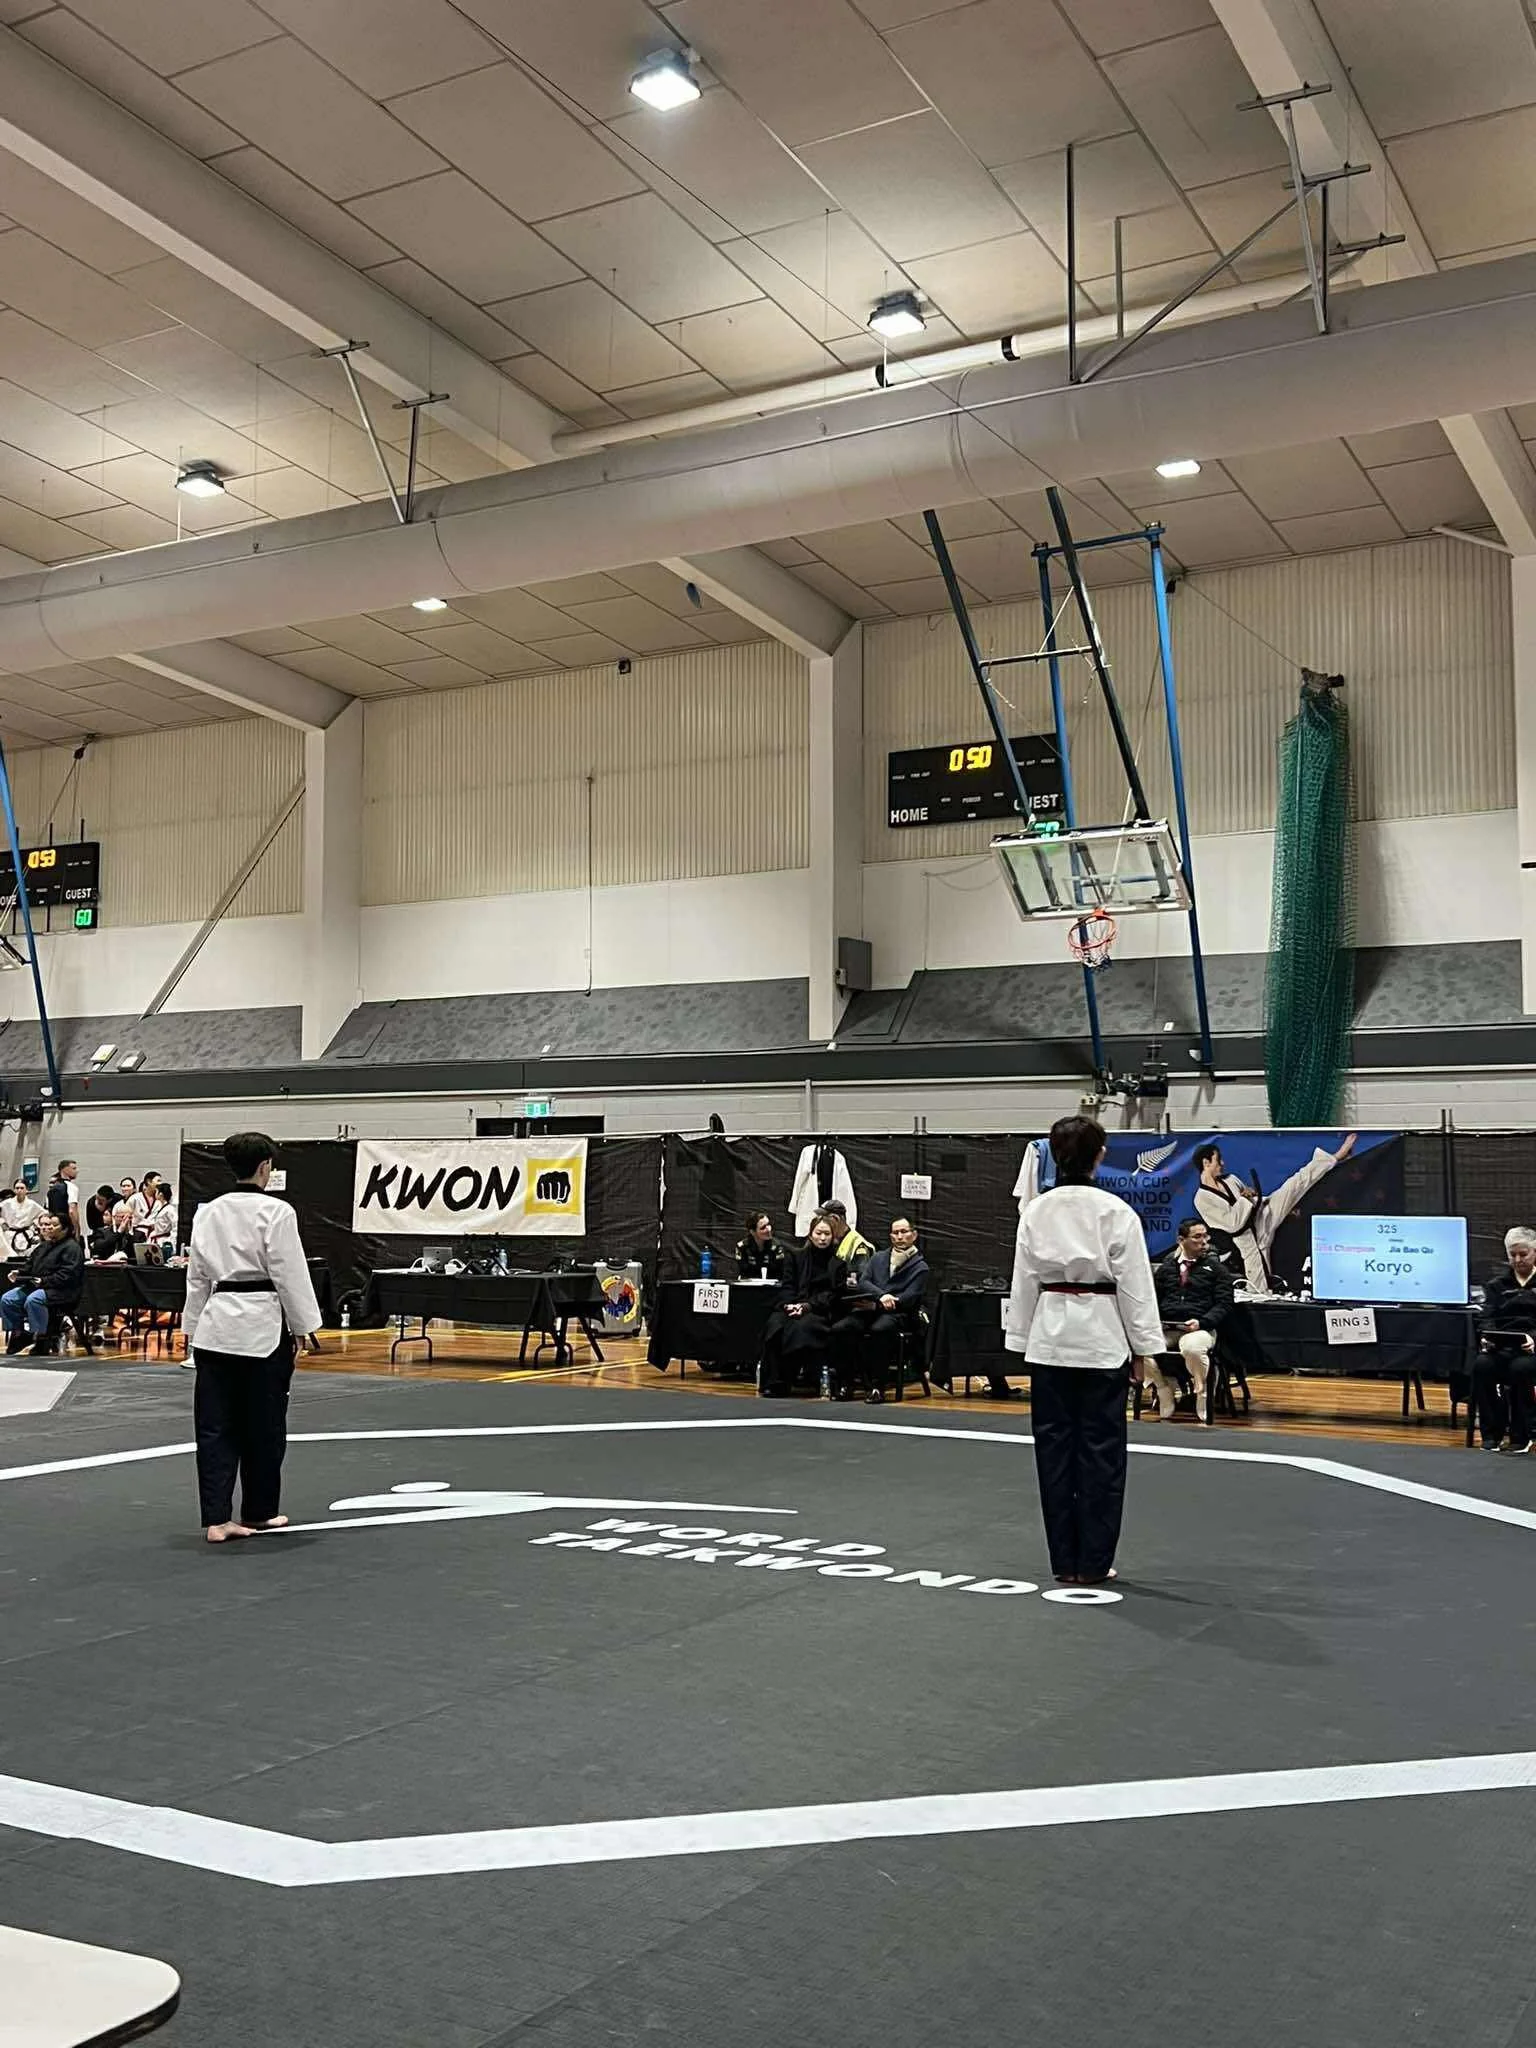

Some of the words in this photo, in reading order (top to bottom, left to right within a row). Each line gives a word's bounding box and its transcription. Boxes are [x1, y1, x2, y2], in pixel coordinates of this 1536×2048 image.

[890, 808, 928, 823] HOME
[65, 888, 92, 900] GUEST
[359, 1163, 521, 1212] KWON
[1142, 1177, 1170, 1188] CUP
[1121, 1191, 1172, 1204] ONDO
[1142, 1220, 1172, 1232] AND
[1364, 1259, 1413, 1276] Koryo
[698, 1289, 724, 1299] FIRST
[702, 1300, 719, 1309] AID
[1331, 1317, 1360, 1327] RING
[1362, 1316, 1370, 1326] 3
[585, 1518, 887, 1556] WORLD
[527, 1532, 1124, 1604] TAEKWONDO
